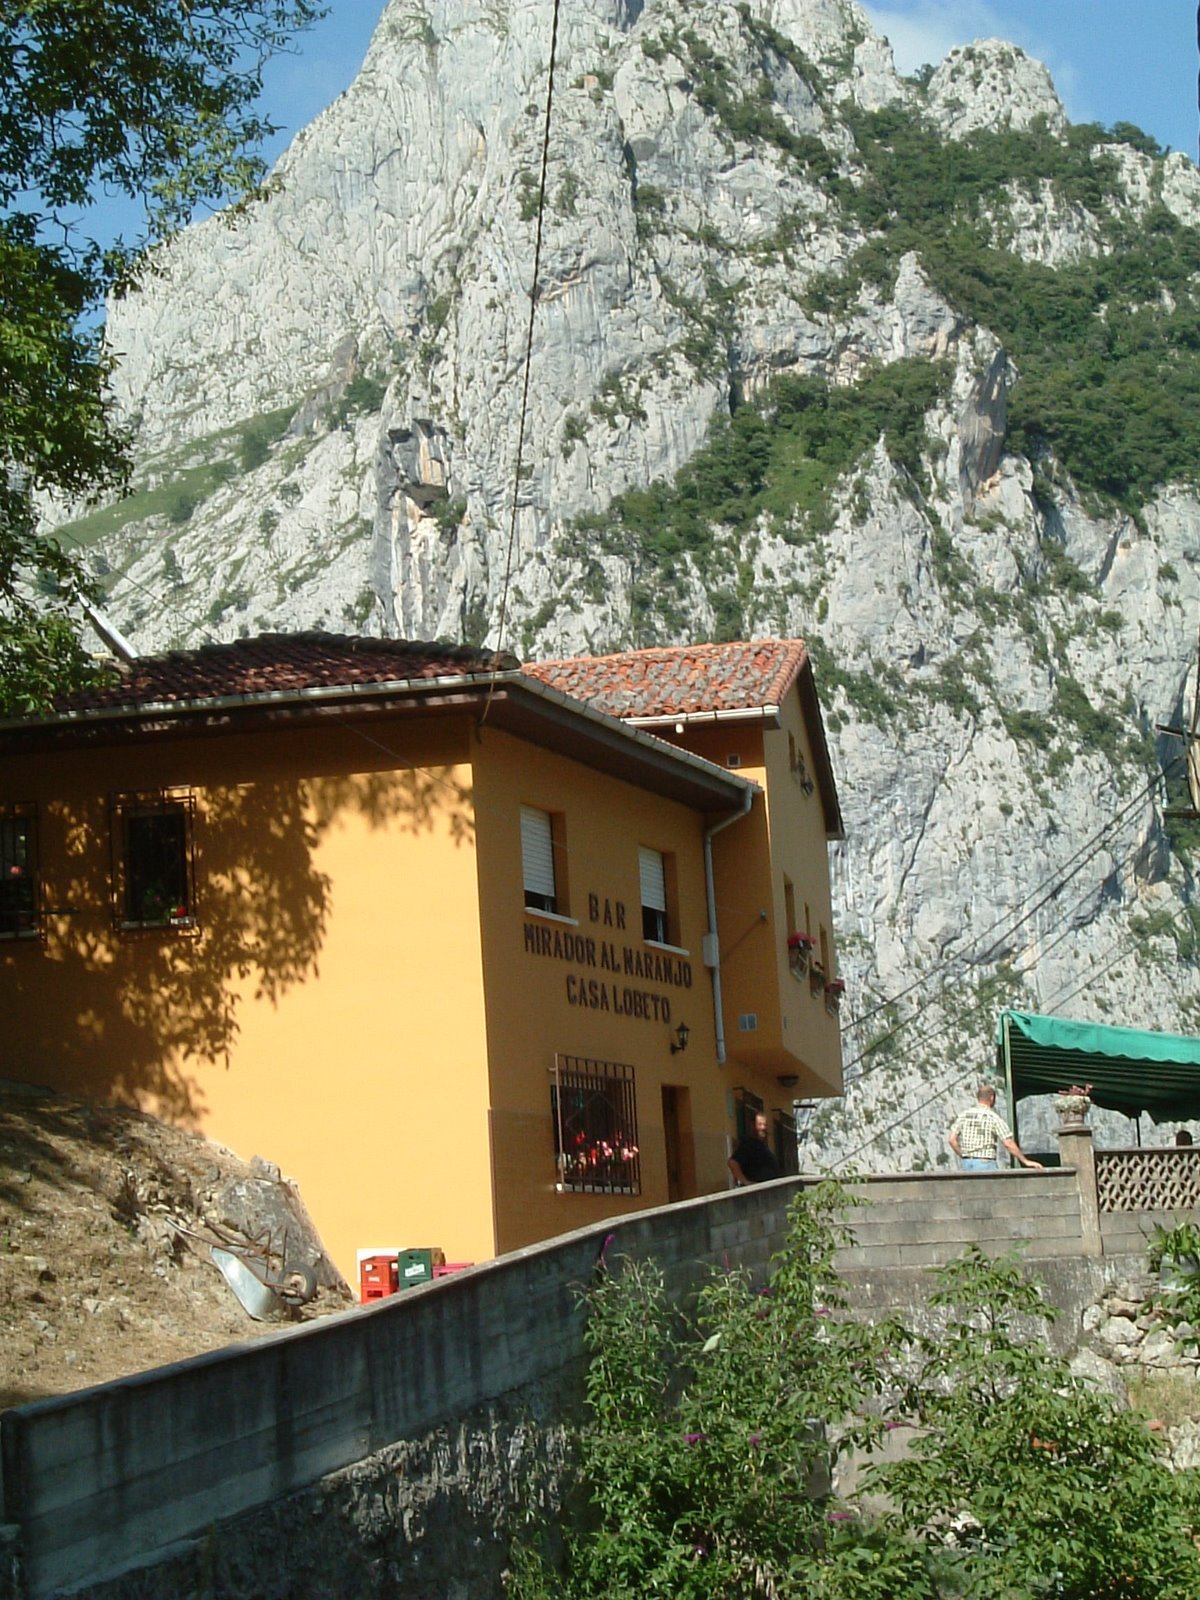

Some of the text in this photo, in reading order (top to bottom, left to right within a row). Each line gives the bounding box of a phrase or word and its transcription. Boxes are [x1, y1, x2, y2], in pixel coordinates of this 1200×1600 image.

[588, 892, 626, 930] BAR
[523, 922, 692, 989] MIRADOR AL NARANJO
[566, 974, 671, 1024] CASA LOBETO
